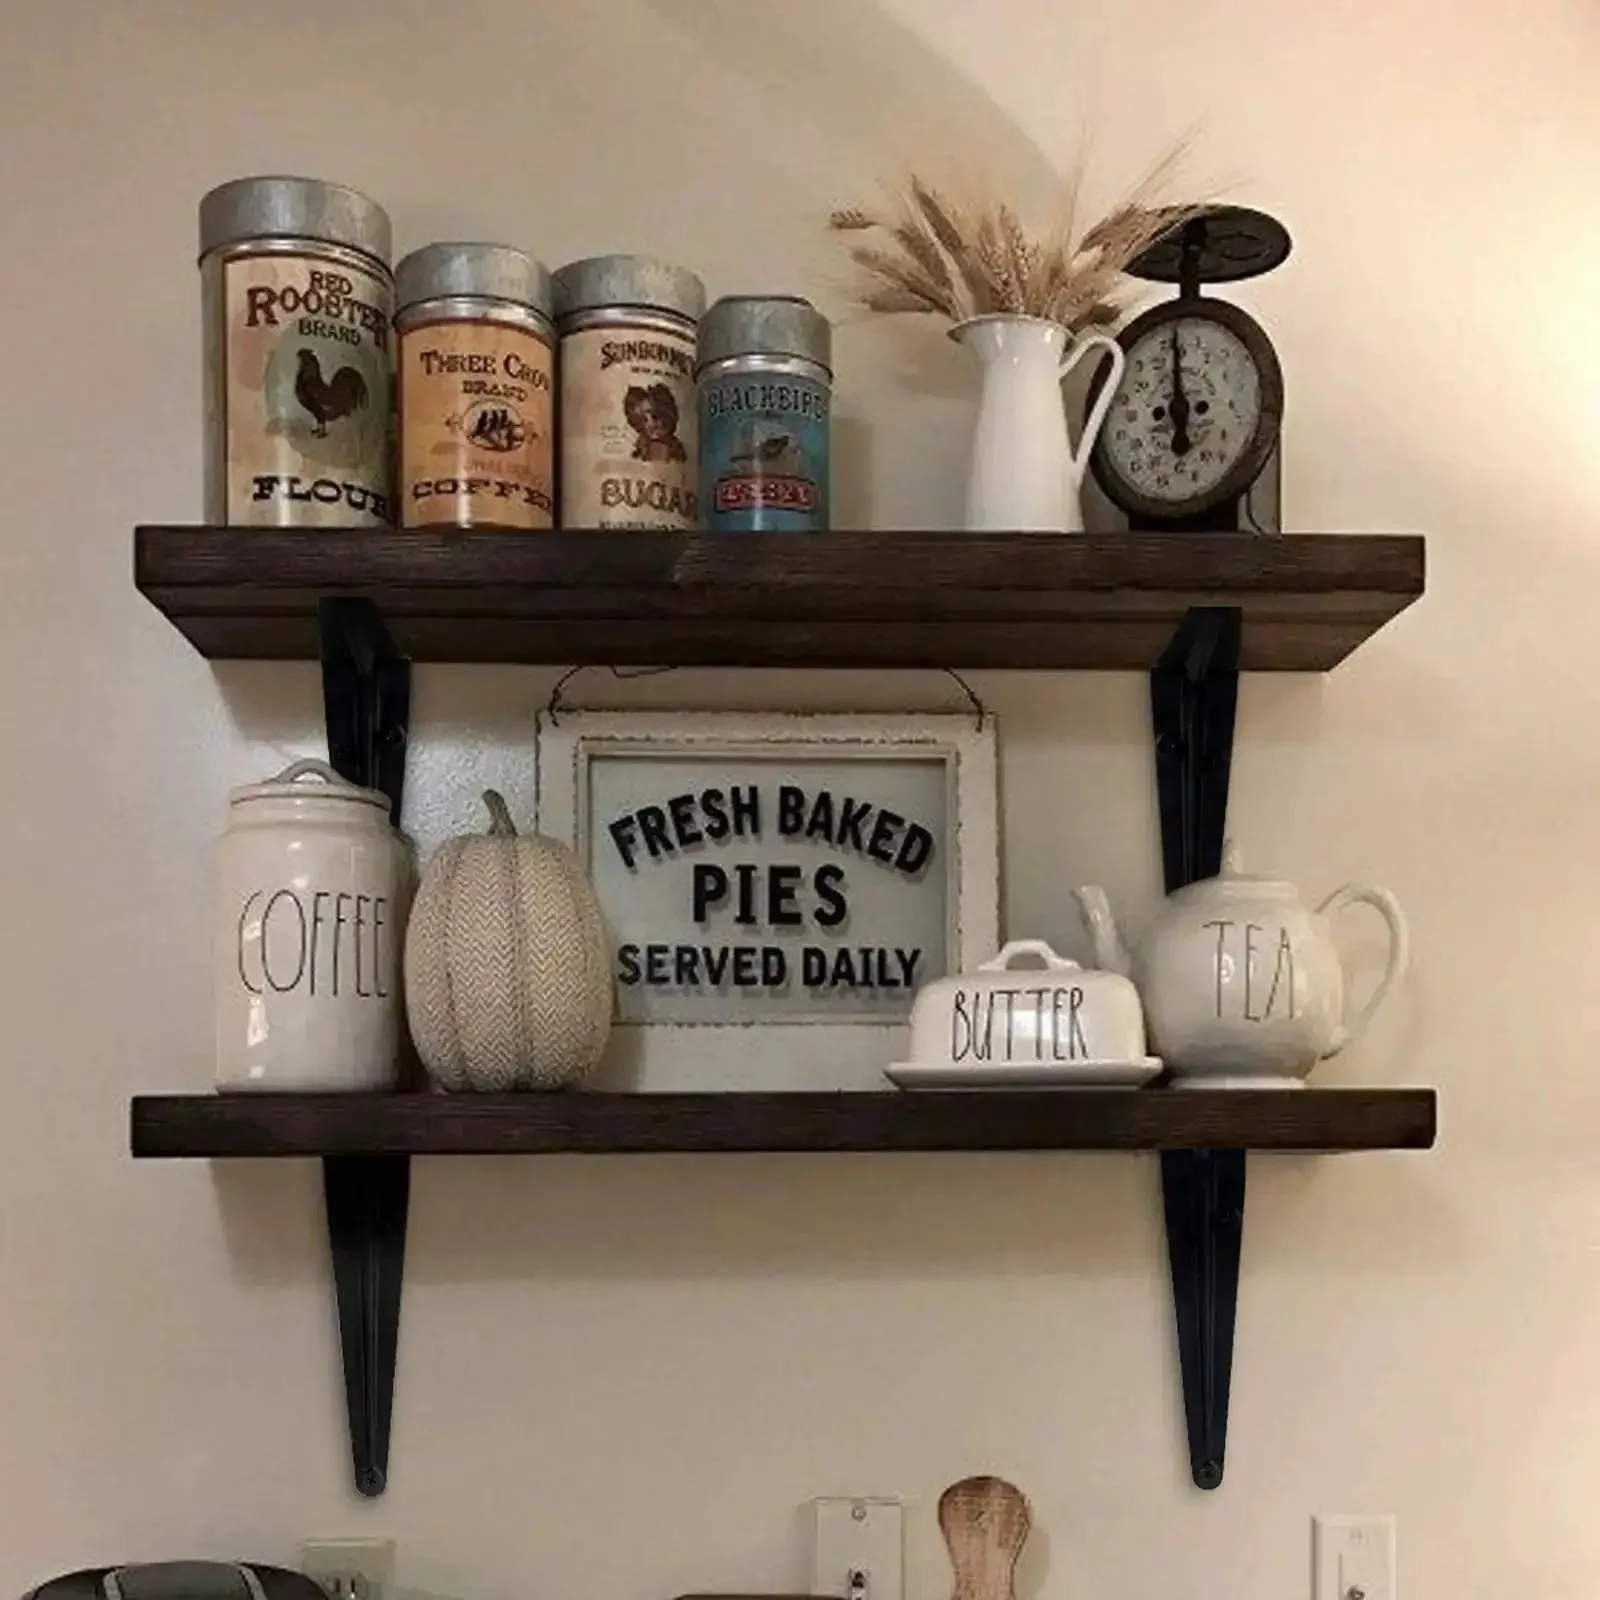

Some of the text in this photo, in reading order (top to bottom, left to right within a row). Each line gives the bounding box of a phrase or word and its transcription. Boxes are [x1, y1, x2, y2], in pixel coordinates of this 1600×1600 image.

[310, 270, 353, 295] RED
[298, 317, 362, 347] BRAND
[420, 349, 497, 375] THREE
[608, 785, 934, 874] FRESH BAKED
[693, 863, 847, 927] PIES
[238, 888, 389, 997] COFFEE
[617, 944, 922, 988] SERVED DAILY
[1203, 920, 1296, 1023] TEA
[952, 987, 1090, 1063] BUTTER
